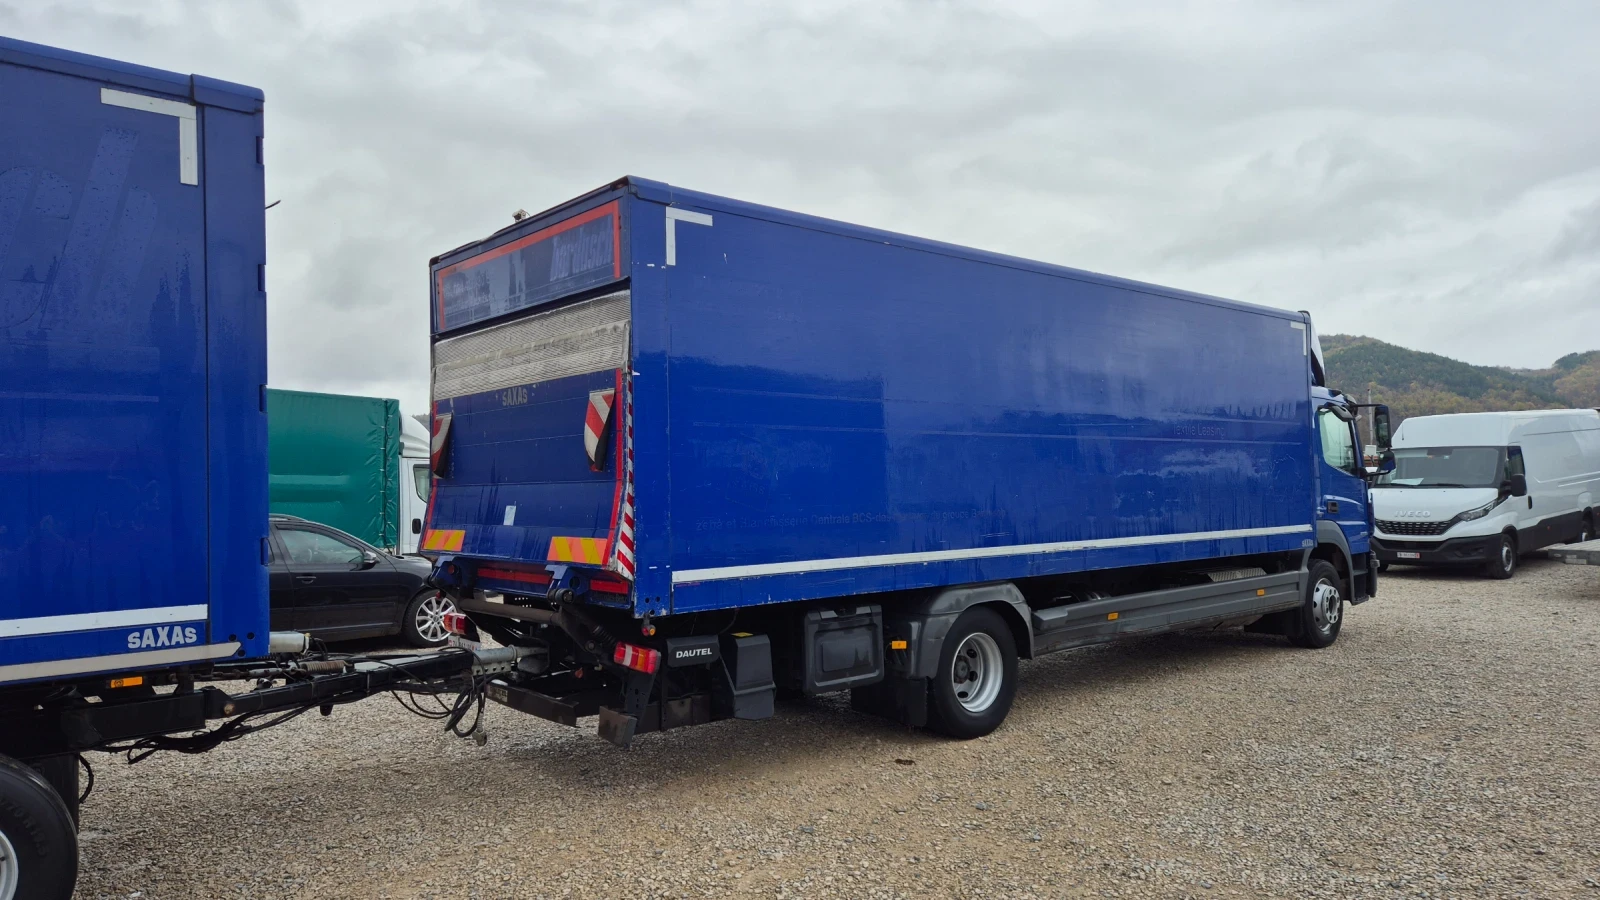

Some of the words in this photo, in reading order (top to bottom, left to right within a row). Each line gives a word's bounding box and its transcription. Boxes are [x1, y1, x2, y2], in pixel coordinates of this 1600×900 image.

[502, 387, 528, 406] SAXAS
[1393, 510, 1431, 518] IVECO
[127, 625, 198, 649] SAXAS
[675, 647, 713, 659] DAUTEL
